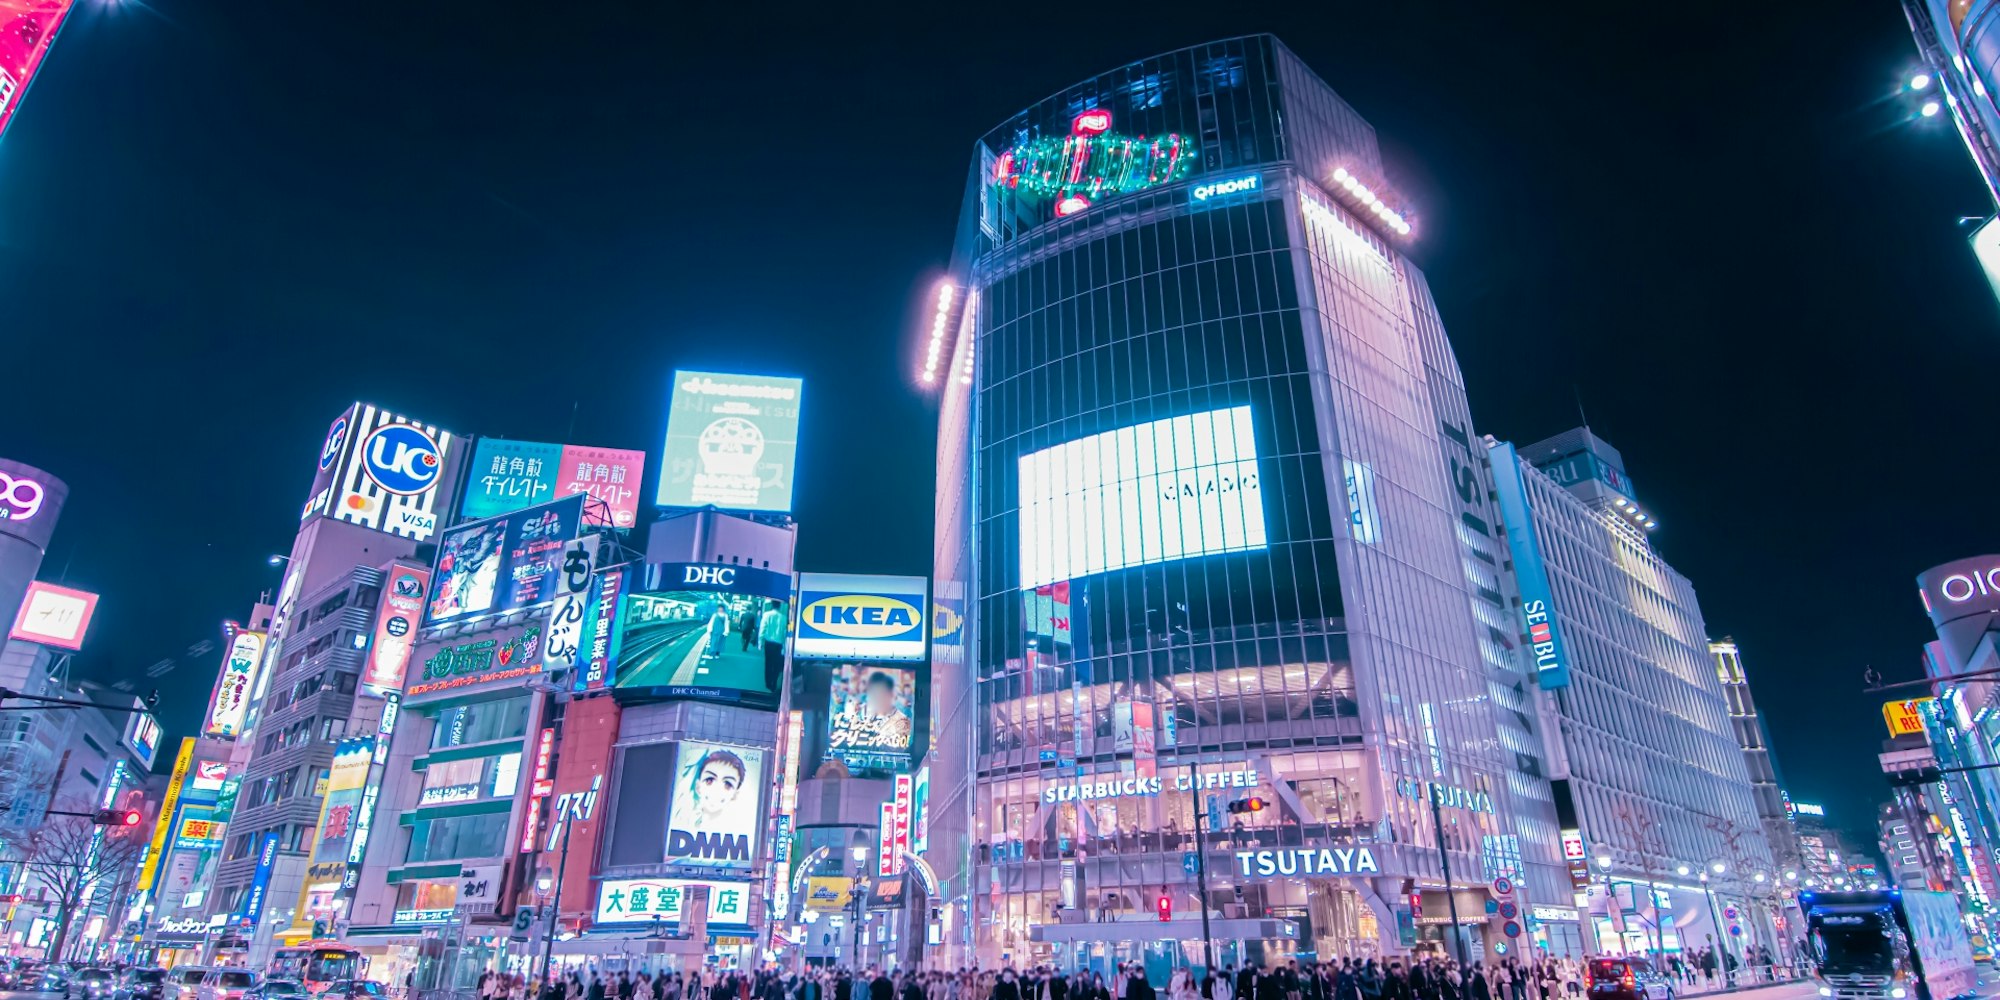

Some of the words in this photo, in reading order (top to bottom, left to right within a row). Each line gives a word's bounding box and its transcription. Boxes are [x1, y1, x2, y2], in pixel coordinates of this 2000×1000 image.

[371, 435, 433, 481] UC
[491, 455, 543, 477] 龍角散
[576, 462, 627, 484] 龍角散
[481, 476, 548, 498] ダイレクト
[402, 512, 433, 530] VISA
[684, 566, 735, 586] DHC
[548, 541, 590, 664] もんじゃ
[813, 605, 913, 626] IKEA
[587, 575, 616, 682] 三千里薬品
[1525, 600, 1558, 672] SEIBU
[672, 687, 688, 695] DHC
[690, 688, 720, 696] Channel
[1046, 776, 1162, 803] STARBUCKS
[1175, 770, 1259, 791] COFFEE
[186, 821, 208, 837] 薬
[667, 829, 749, 861] DMM
[1236, 848, 1378, 876] TSUTAYA
[157, 916, 211, 933] グルメタウン
